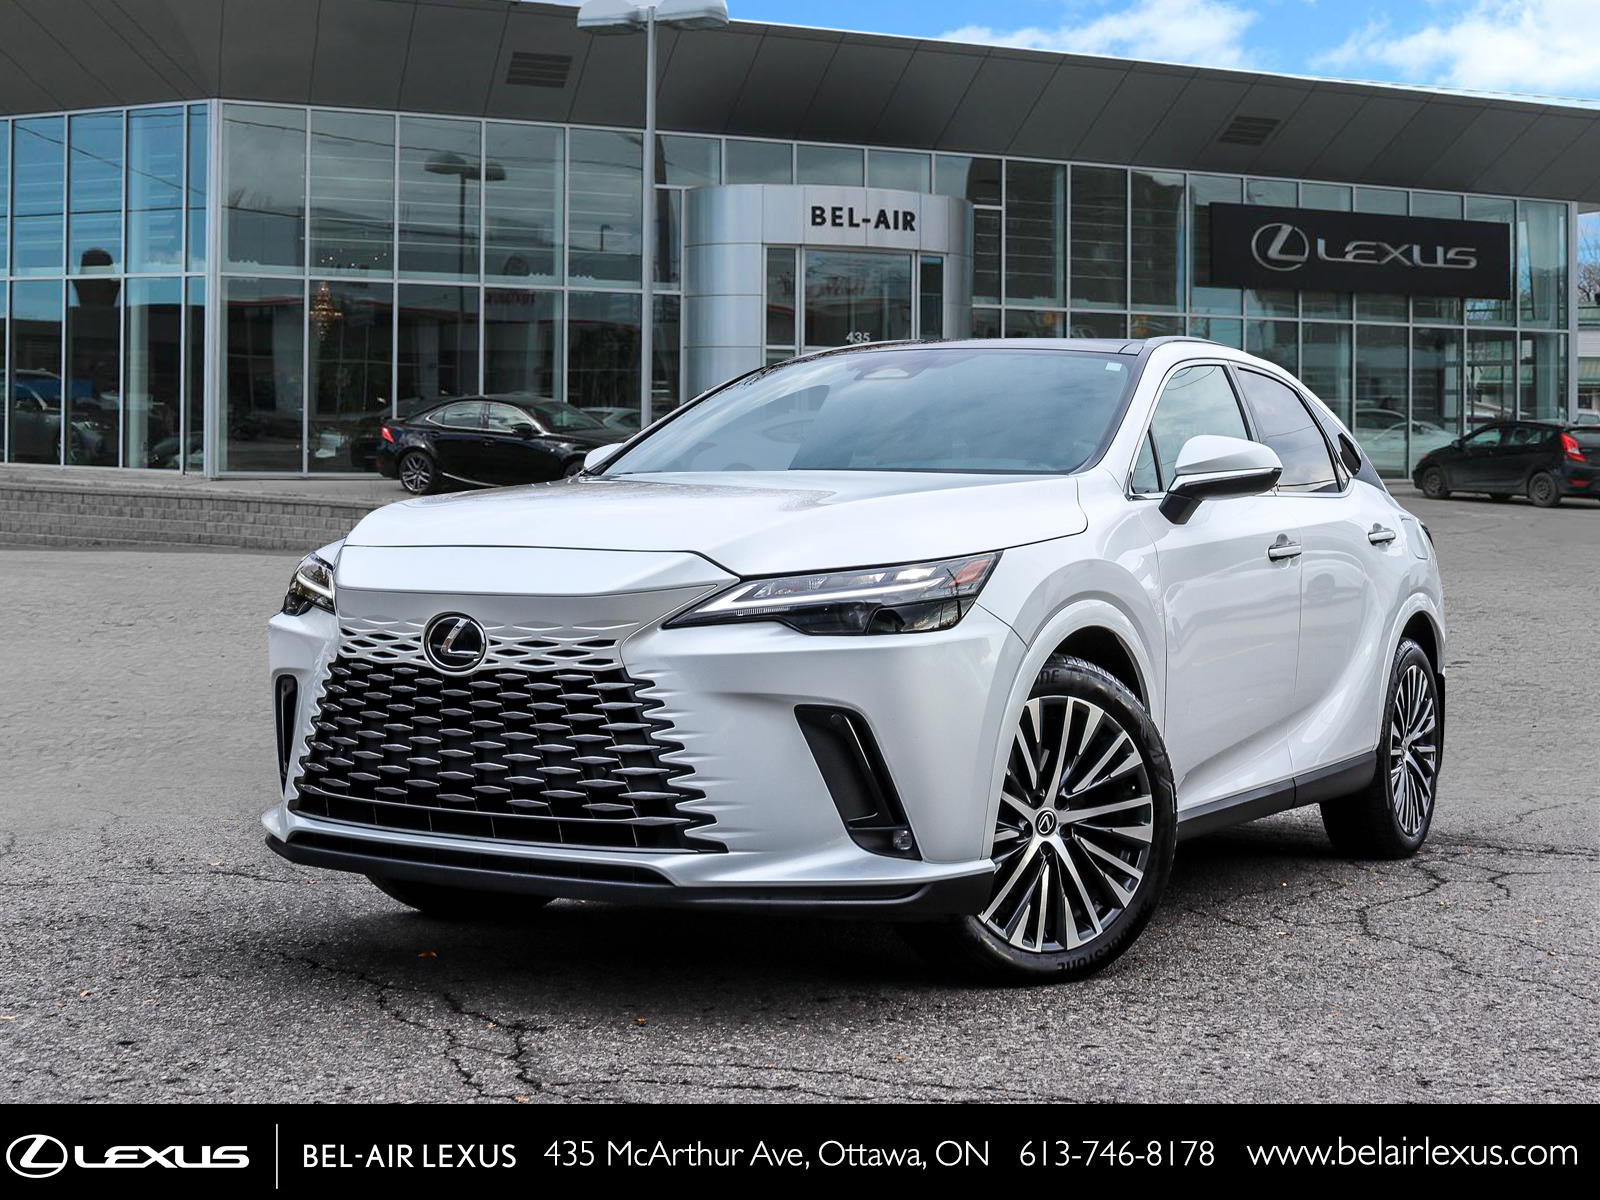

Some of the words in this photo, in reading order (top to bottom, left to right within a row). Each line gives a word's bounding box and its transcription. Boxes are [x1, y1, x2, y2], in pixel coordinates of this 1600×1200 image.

[811, 205, 916, 232] BEL-AIR
[1316, 238, 1477, 269] LEXUS
[845, 331, 871, 343] 435
